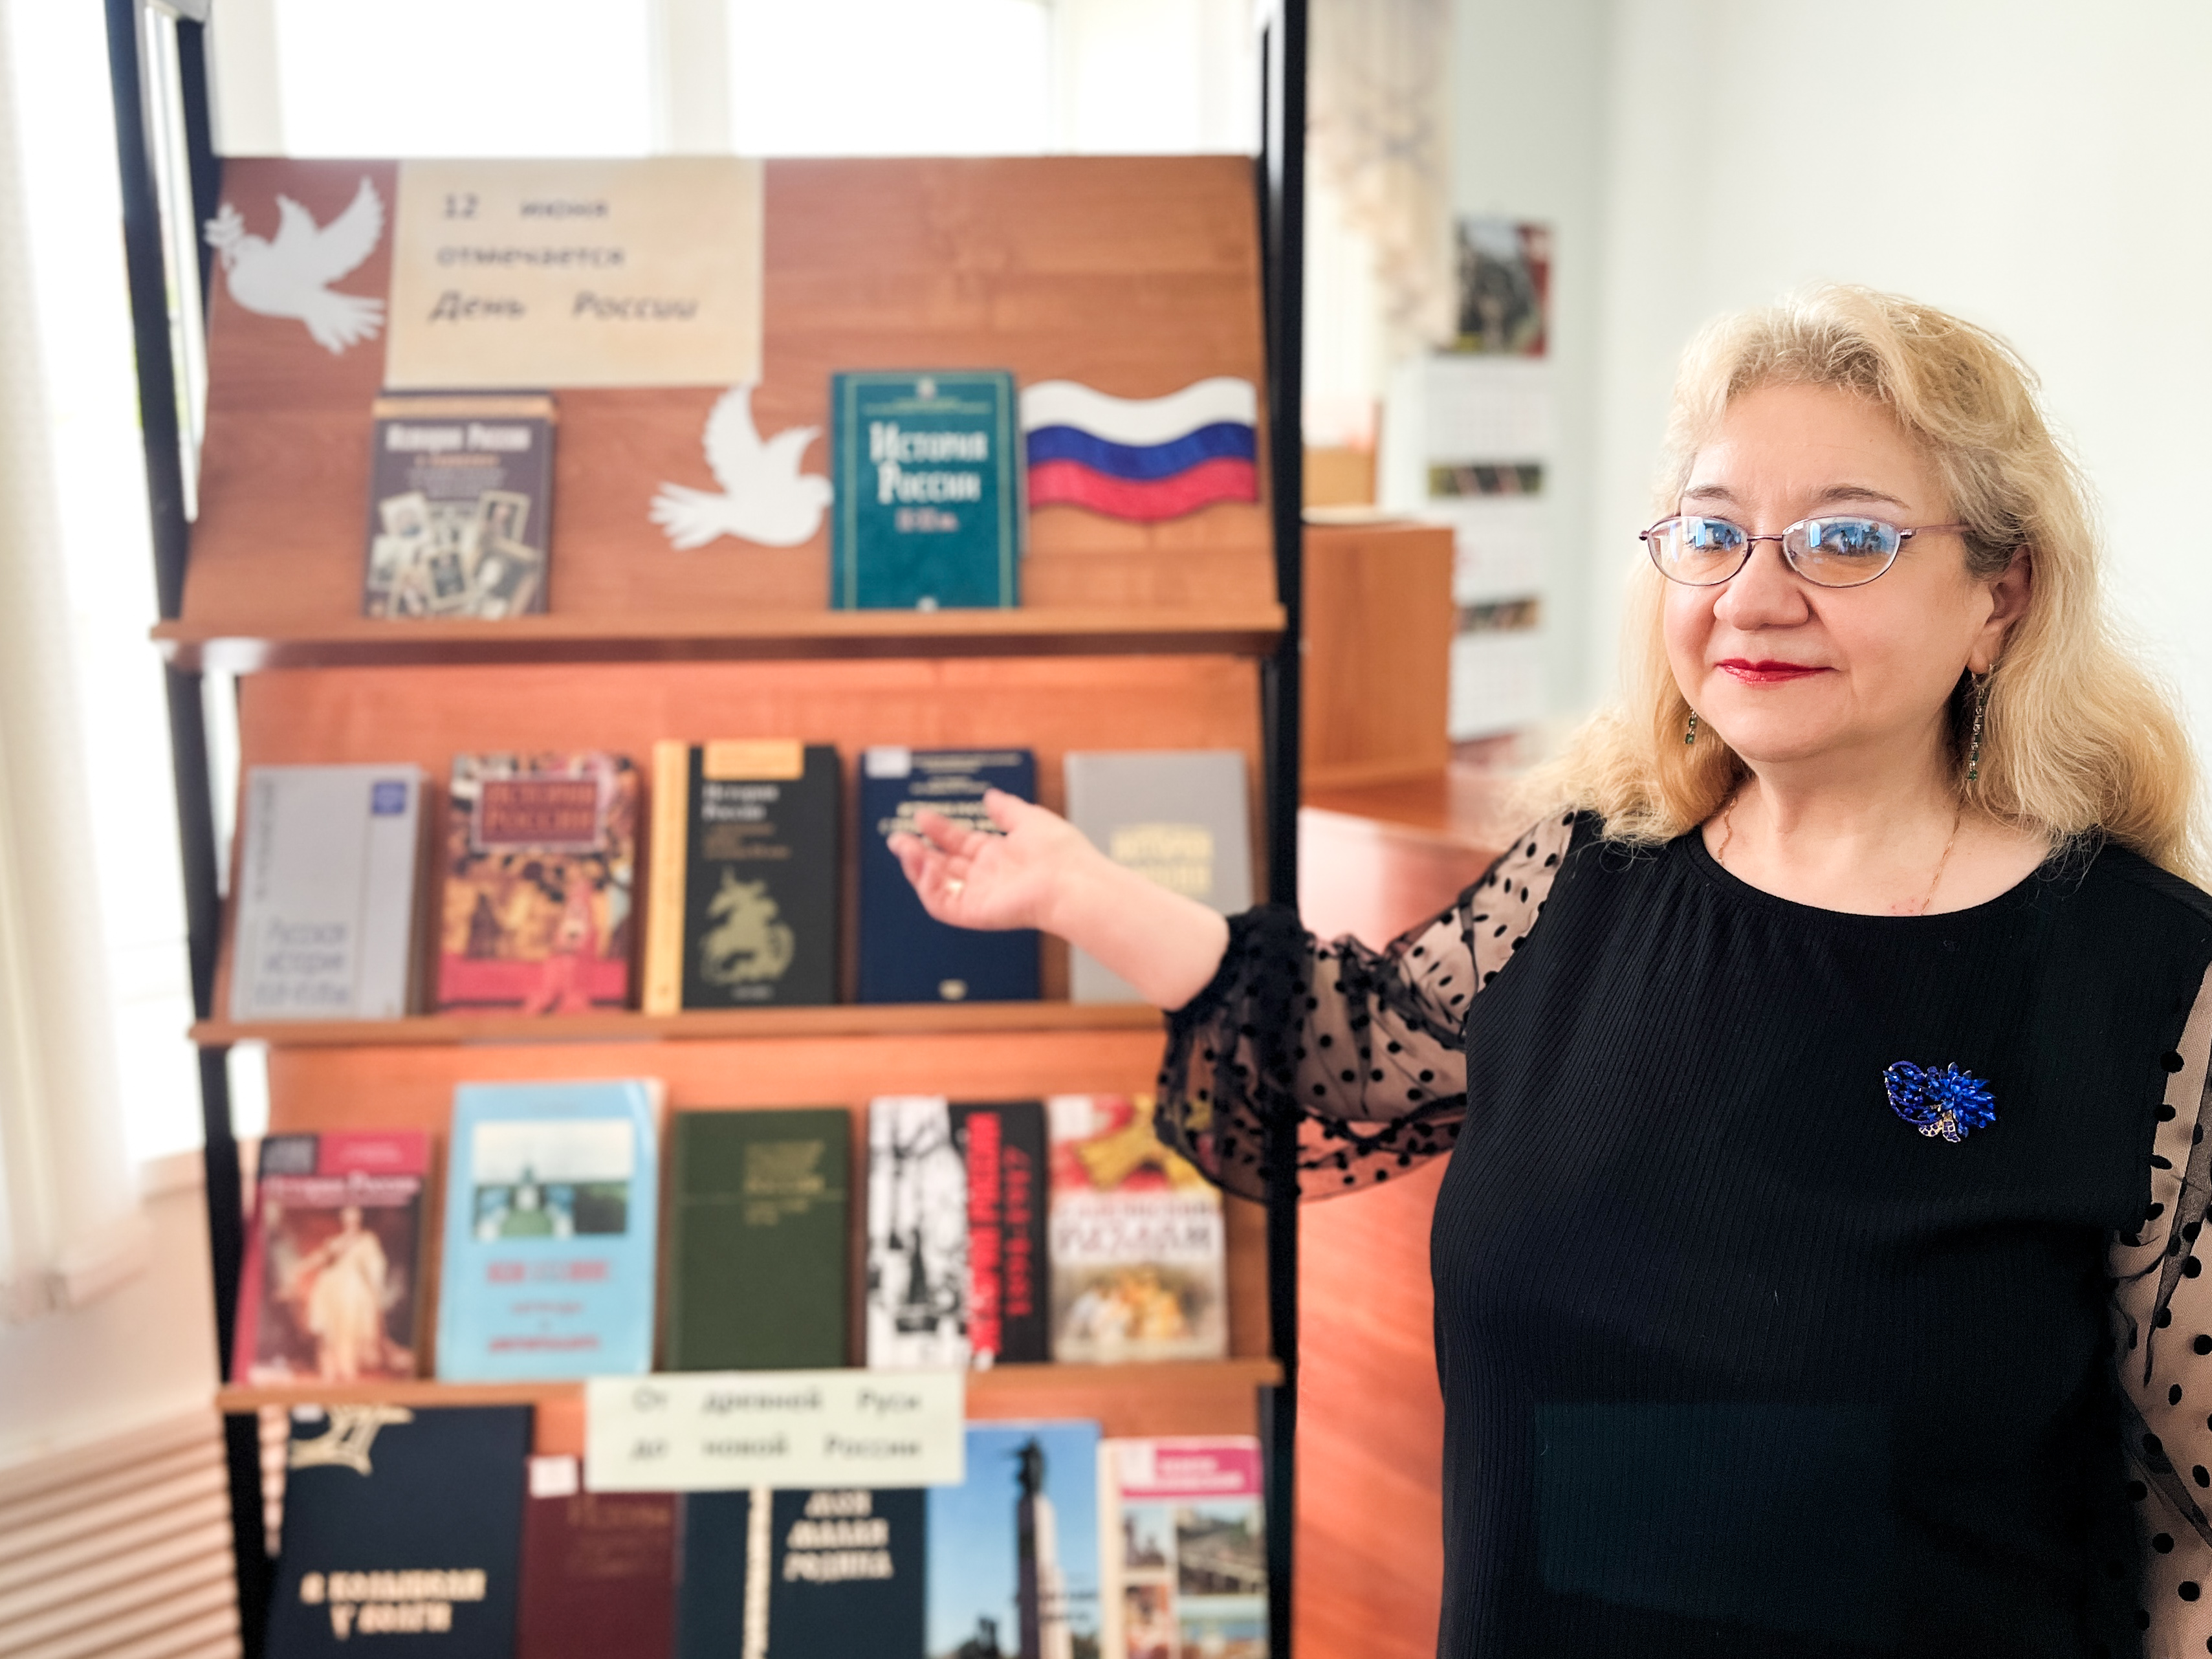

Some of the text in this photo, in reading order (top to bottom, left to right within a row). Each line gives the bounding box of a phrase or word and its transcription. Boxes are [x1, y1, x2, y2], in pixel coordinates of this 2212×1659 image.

[443, 193, 608, 220] 12 июня
[436, 246, 626, 268] отмечается
[428, 291, 697, 323] День России
[633, 1385, 921, 1417] От древней Руси
[631, 1434, 921, 1460] до новой России
